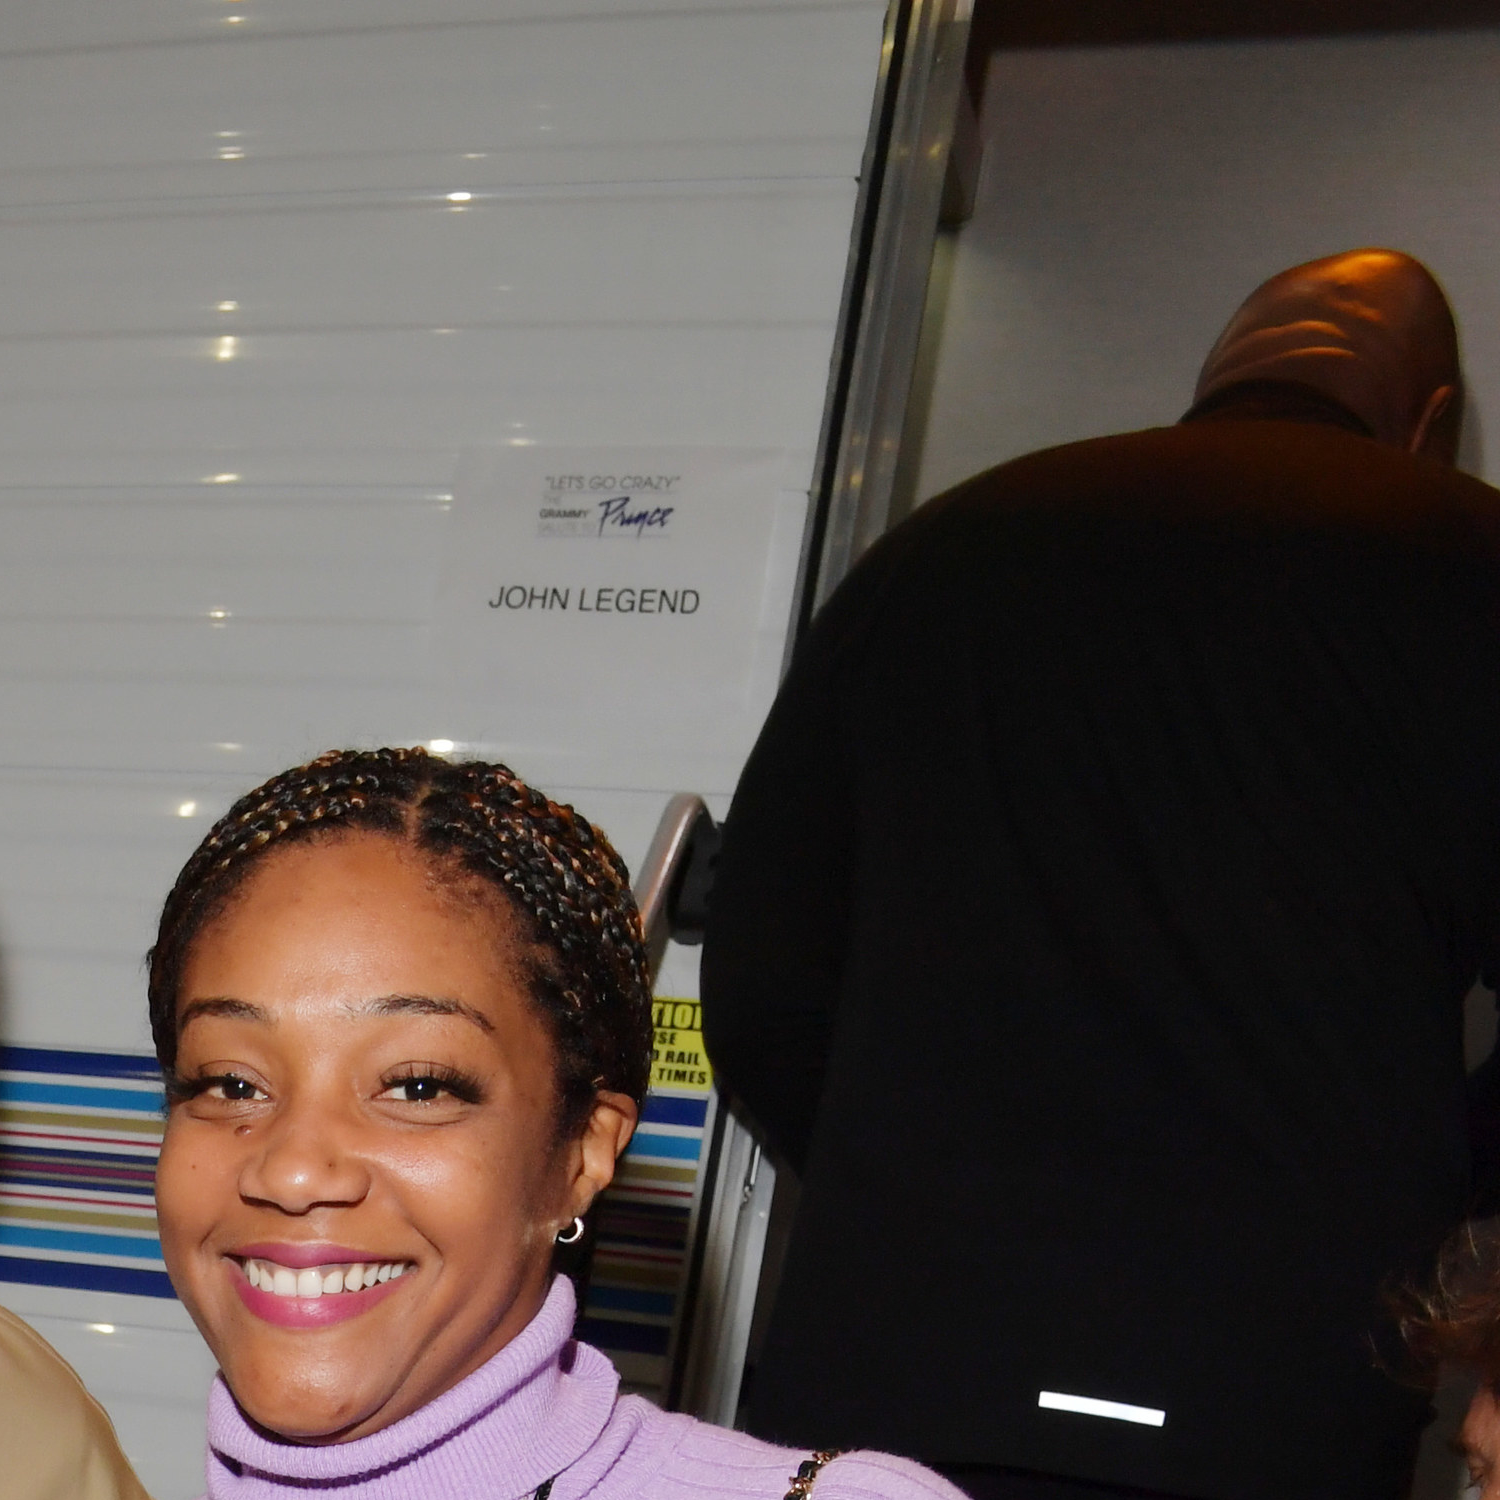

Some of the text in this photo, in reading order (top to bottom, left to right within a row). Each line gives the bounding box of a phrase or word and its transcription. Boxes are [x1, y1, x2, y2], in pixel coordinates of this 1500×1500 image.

[588, 475, 617, 491] GO
[538, 508, 589, 519] GRAMMY
[597, 496, 675, 538] Prince
[489, 585, 700, 614] JOHN LEGEND
[665, 1050, 700, 1066] RAIL
[658, 1068, 707, 1085] TIMES
